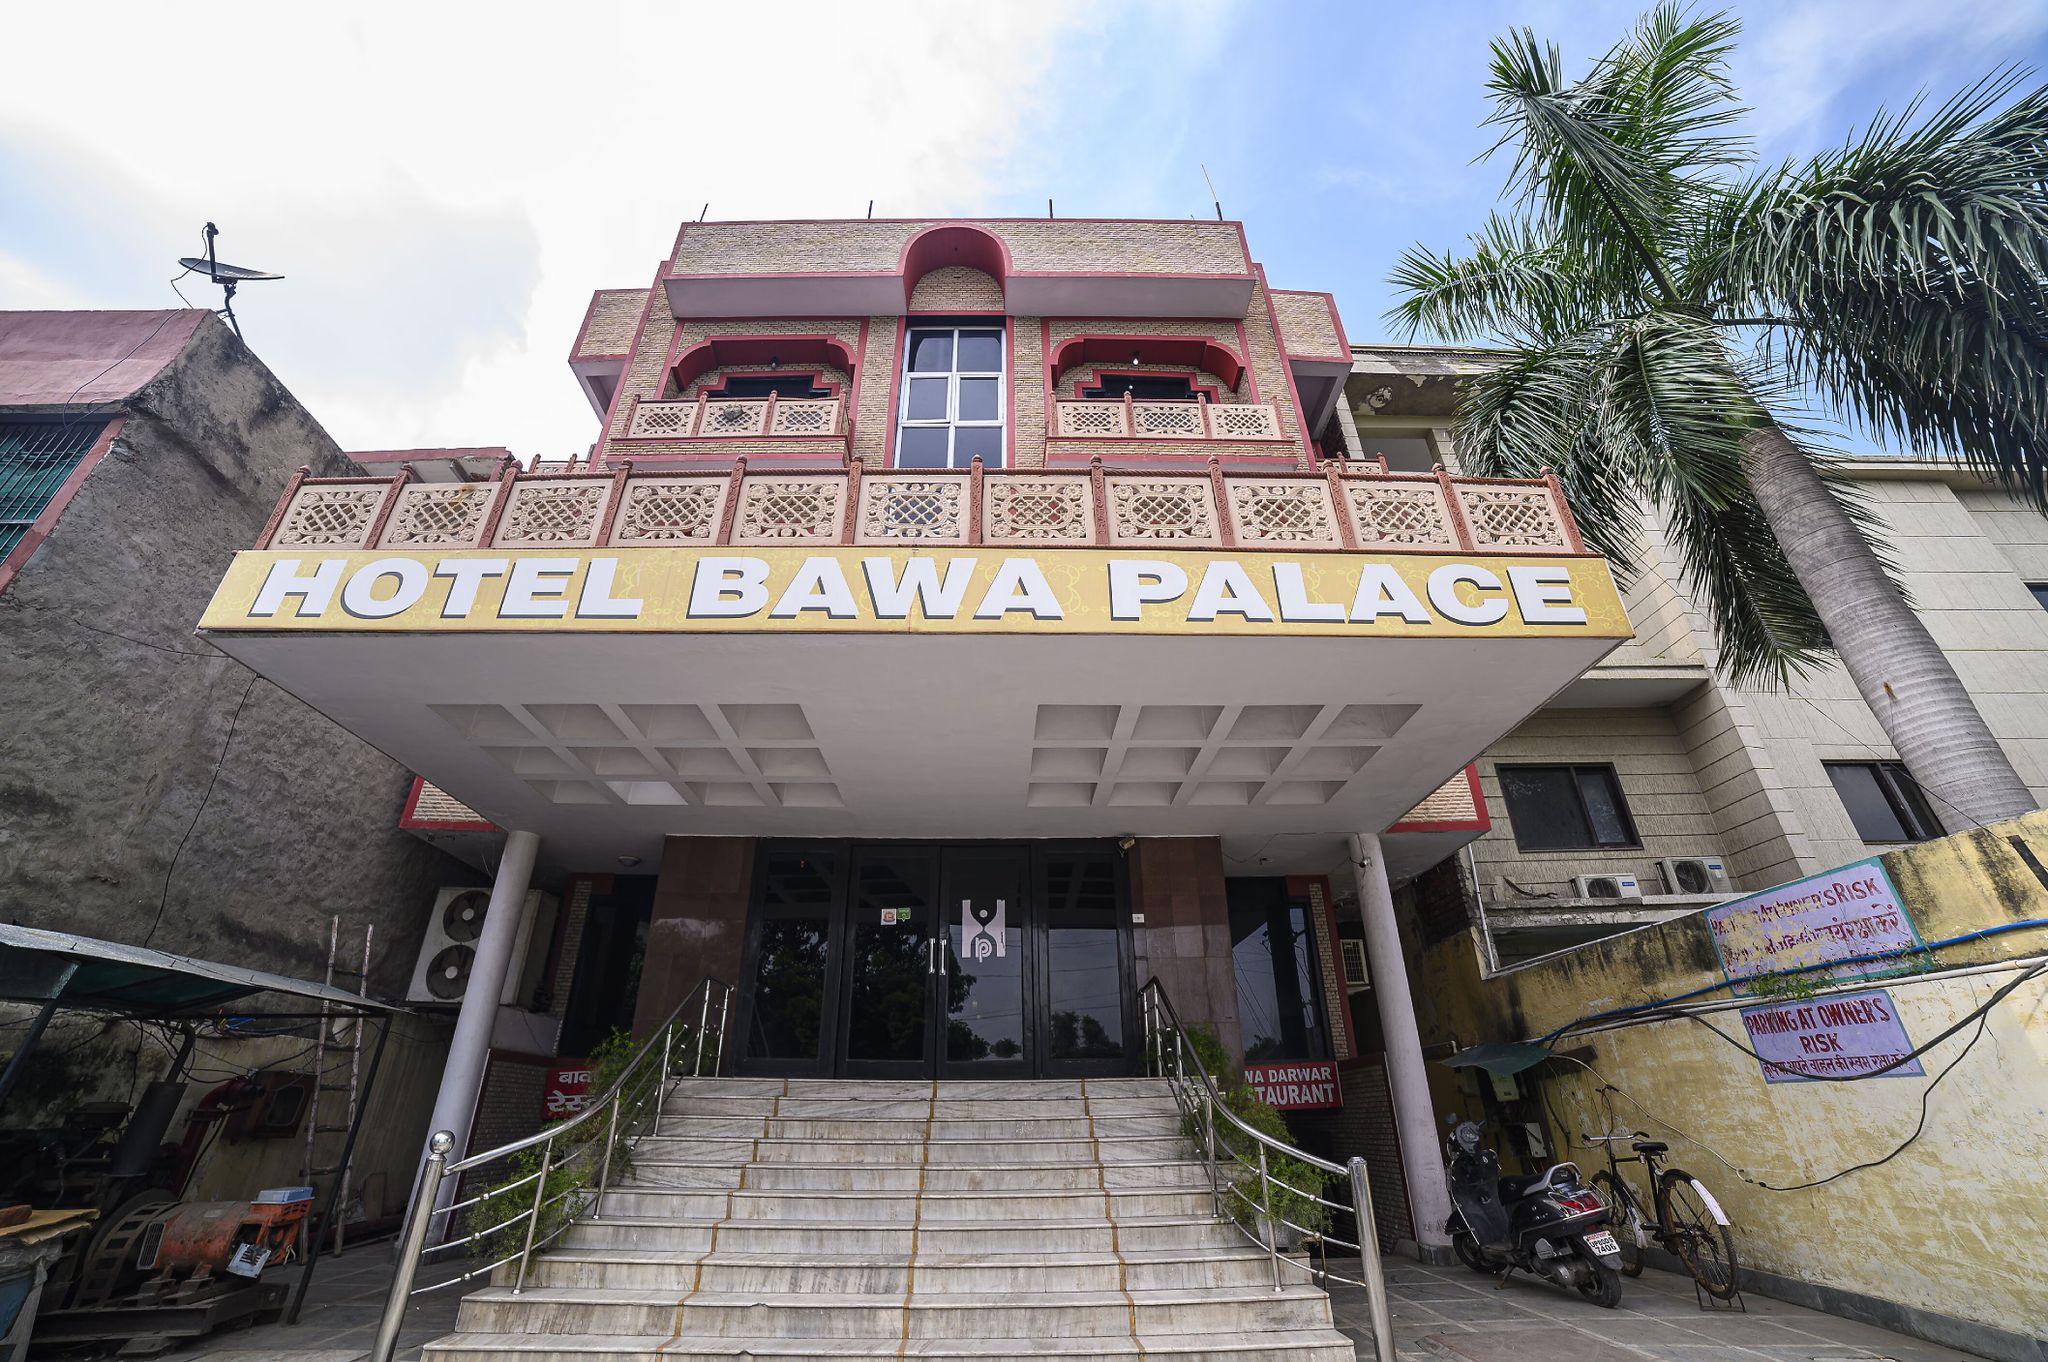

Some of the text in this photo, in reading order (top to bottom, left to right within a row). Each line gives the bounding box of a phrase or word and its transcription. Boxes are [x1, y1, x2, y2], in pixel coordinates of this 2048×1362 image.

[247, 556, 1588, 626] HOTEL BAWA PALACE
[1832, 877, 1883, 904] RISK
[1745, 997, 1890, 1035] PARKING AT OWNER'S
[1799, 1032, 1844, 1055] RISK
[1268, 1067, 1332, 1082] DARWAR
[1248, 1083, 1335, 1105] TAURANT
